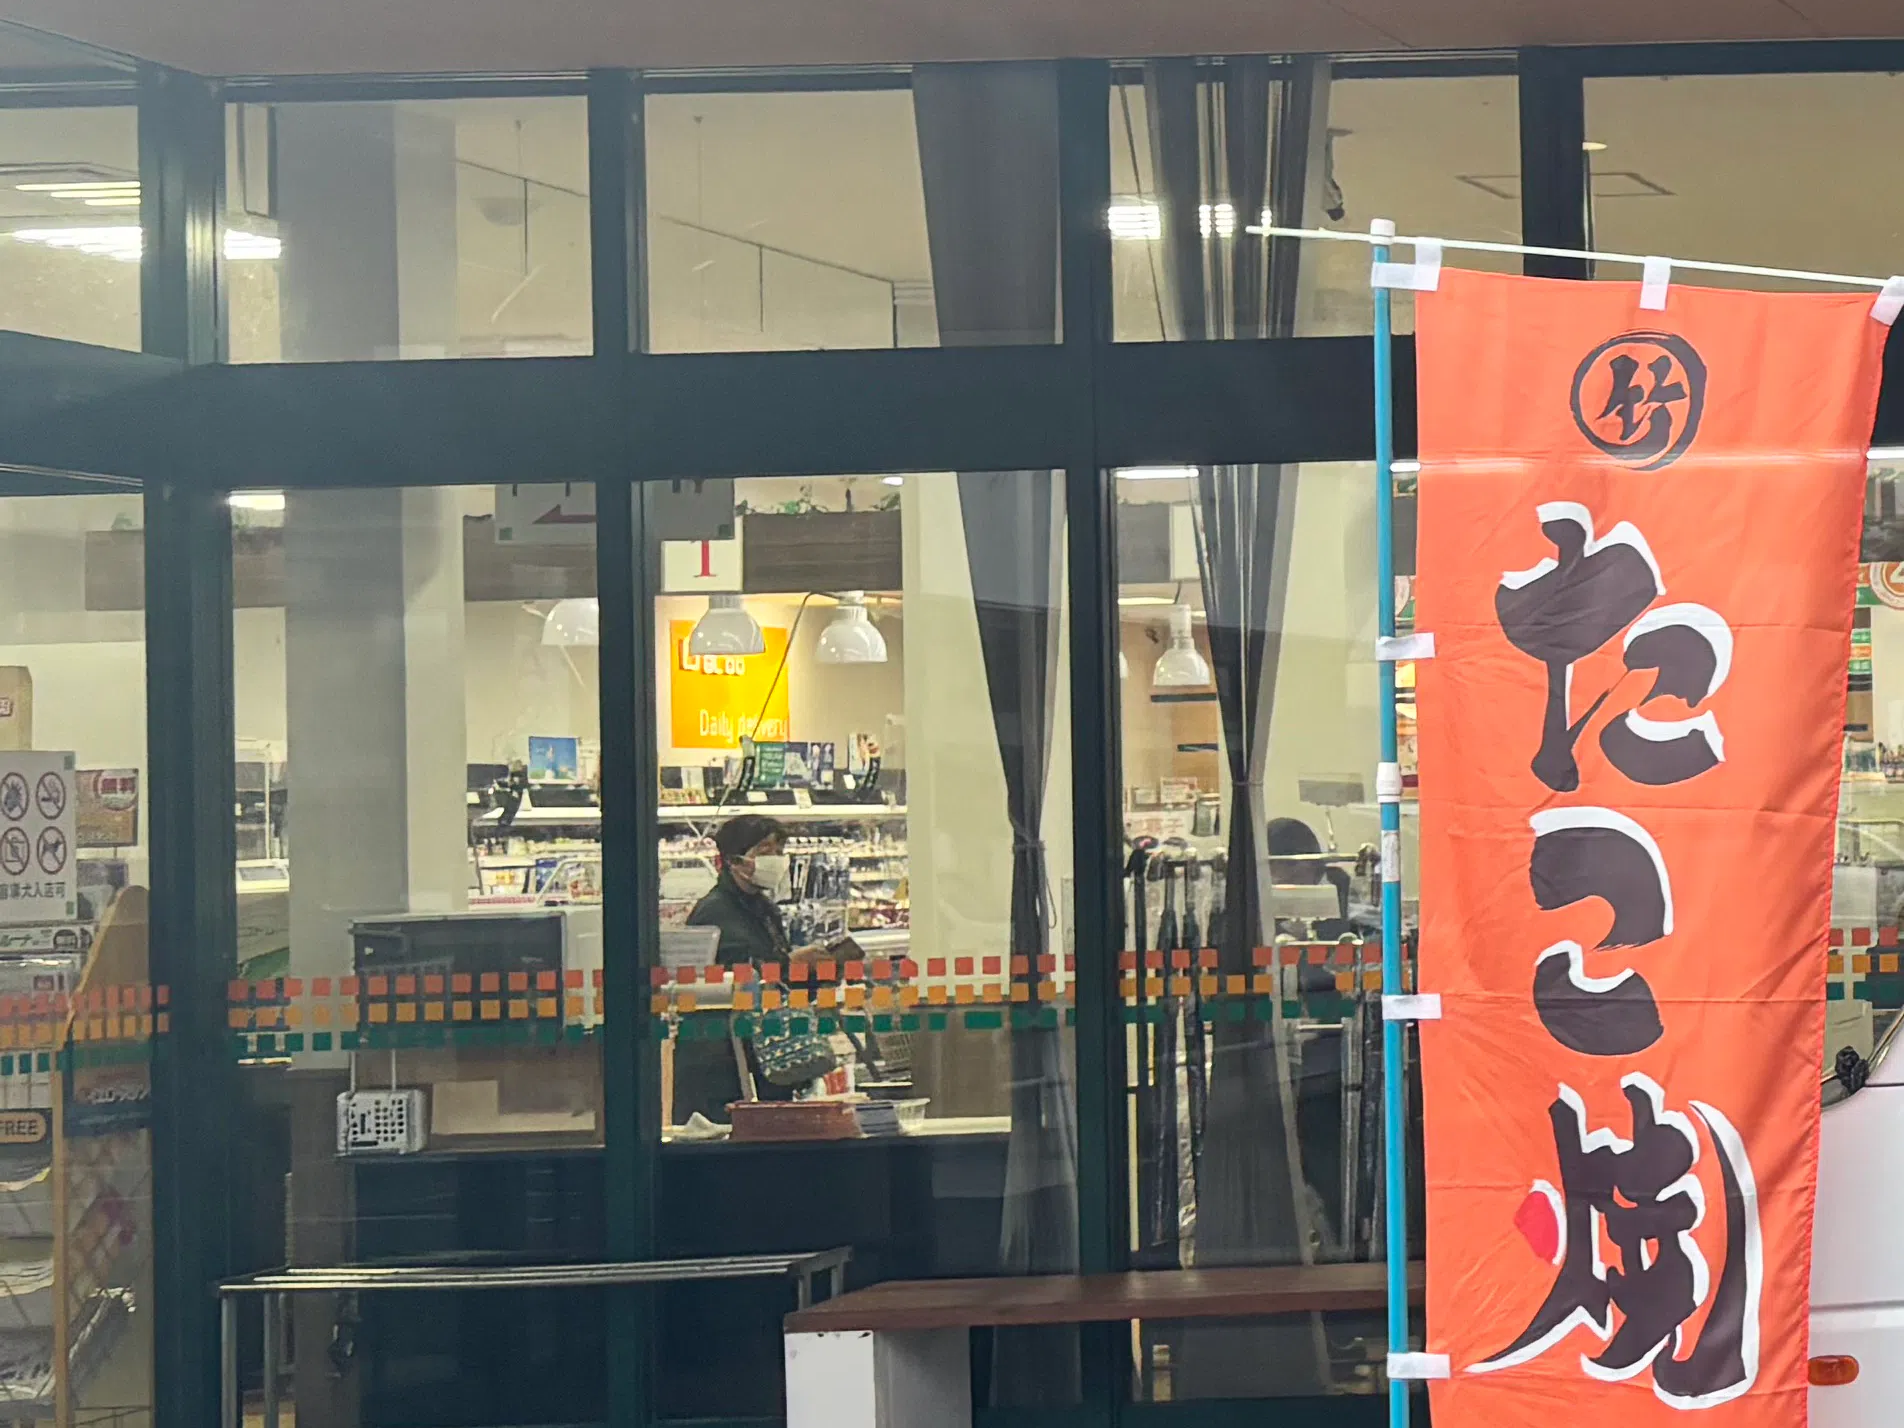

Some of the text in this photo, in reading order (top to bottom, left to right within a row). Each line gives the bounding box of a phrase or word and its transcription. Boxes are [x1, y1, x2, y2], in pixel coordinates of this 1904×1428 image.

[1588, 344, 1695, 460] 竹
[700, 709, 735, 743] Daily
[1465, 500, 1760, 1410] たこ焼
